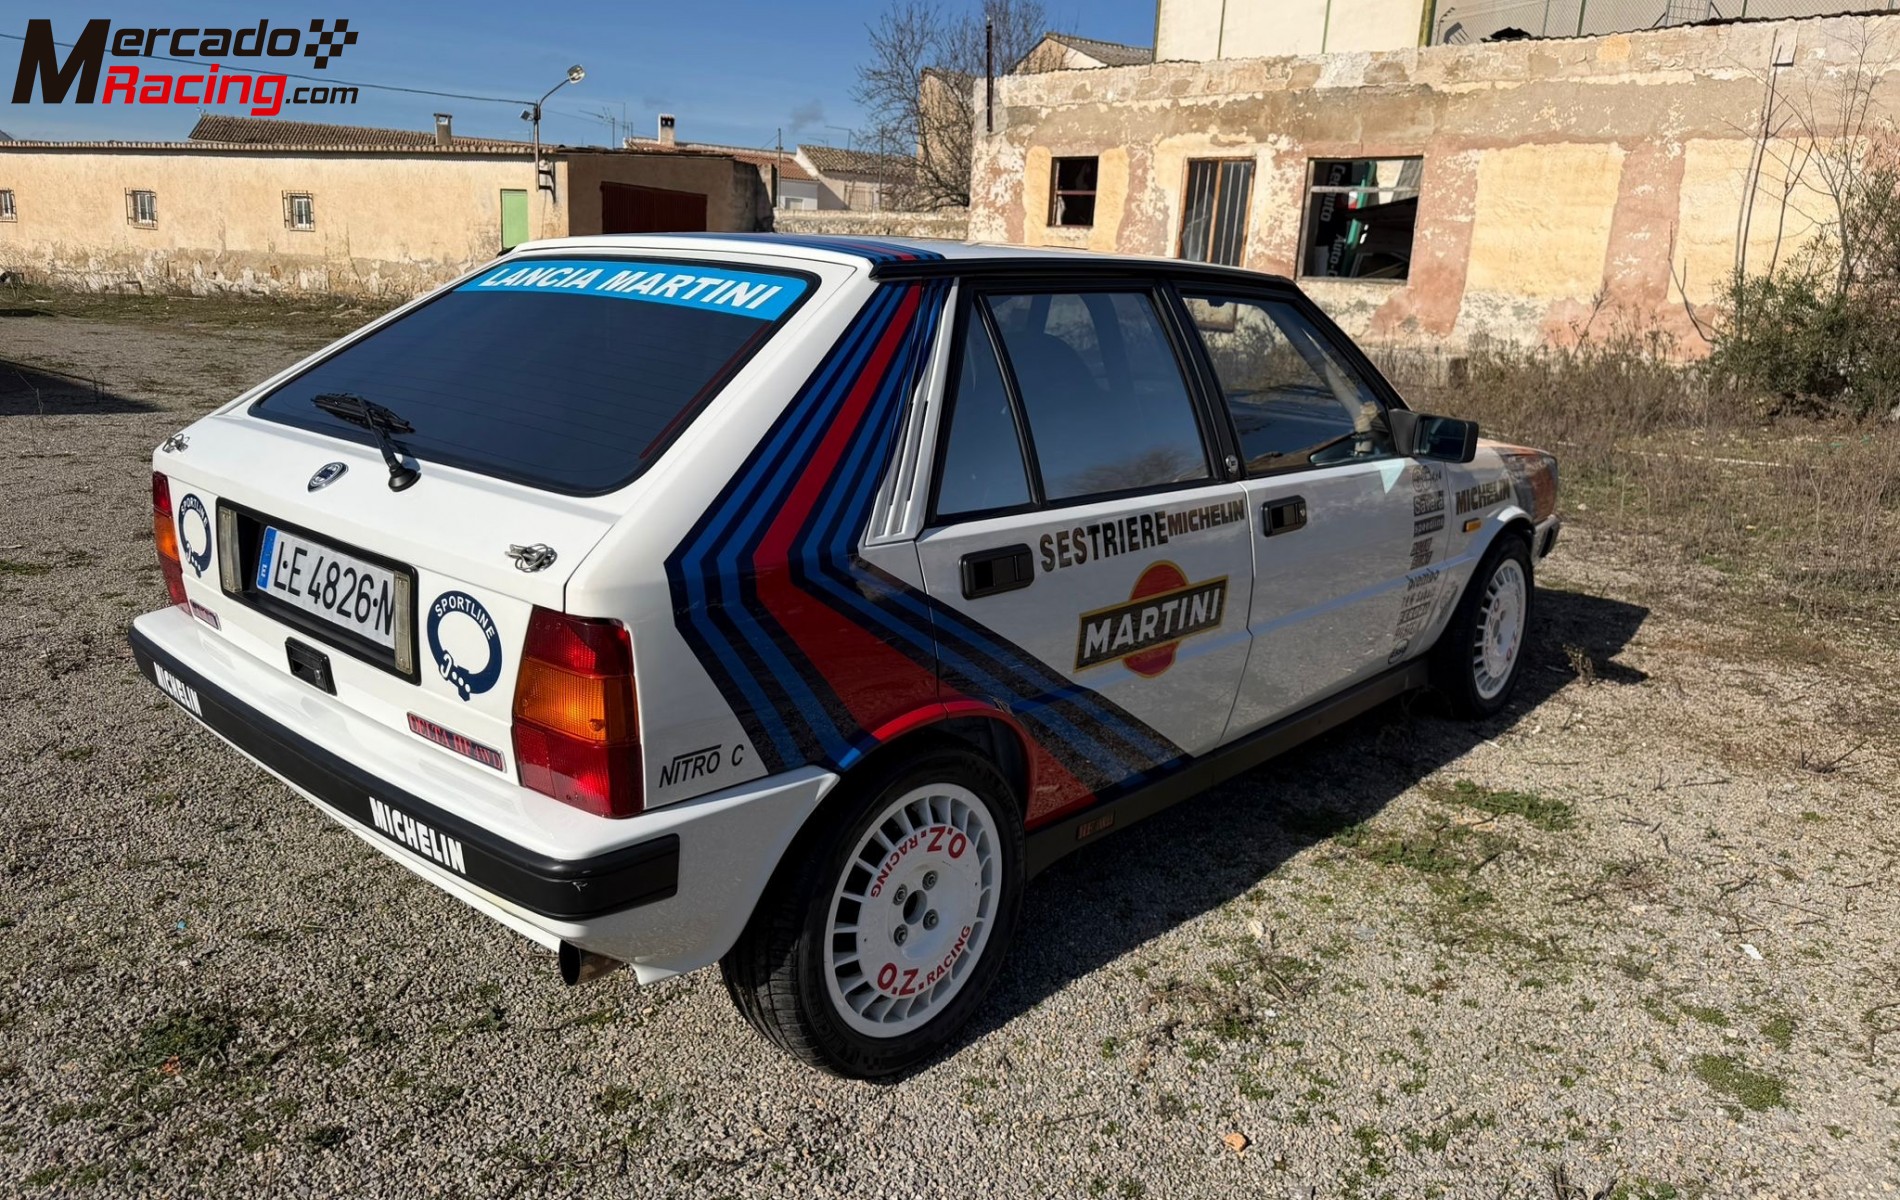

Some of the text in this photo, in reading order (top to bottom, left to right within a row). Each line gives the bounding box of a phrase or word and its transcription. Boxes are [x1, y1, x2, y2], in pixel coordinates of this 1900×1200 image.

[477, 266, 783, 310] LANCIA MARTINI
[180, 496, 208, 527] SPORTLINE
[1455, 478, 1511, 516] MICHELIN
[1039, 499, 1245, 573] SESTRIERE MICHELIN
[434, 594, 496, 640] SPORTLINE
[1083, 587, 1221, 659] MARTINI
[153, 661, 203, 718] MICHELIN
[408, 713, 503, 770] DELTA HF 4WD
[658, 745, 723, 788] NITRO
[368, 796, 466, 875] MICHELIN
